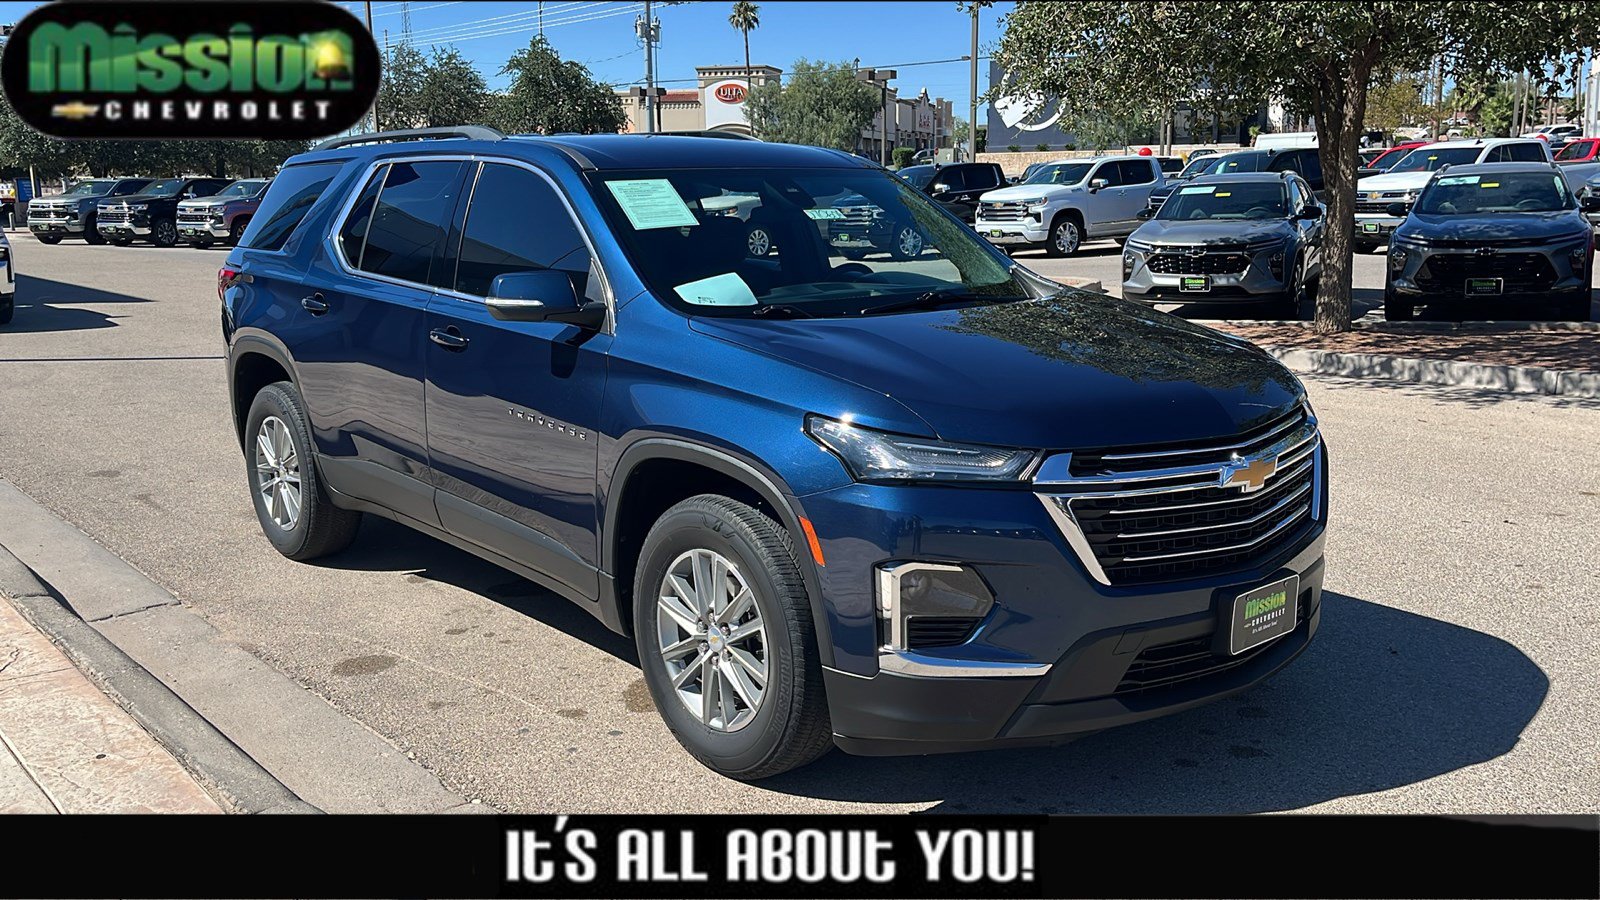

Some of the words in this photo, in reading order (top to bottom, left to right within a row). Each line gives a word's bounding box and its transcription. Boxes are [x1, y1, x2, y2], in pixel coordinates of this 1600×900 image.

[719, 87, 744, 96] ULTA
[508, 407, 587, 441] TRAVERSE
[1244, 591, 1286, 620] Mission
